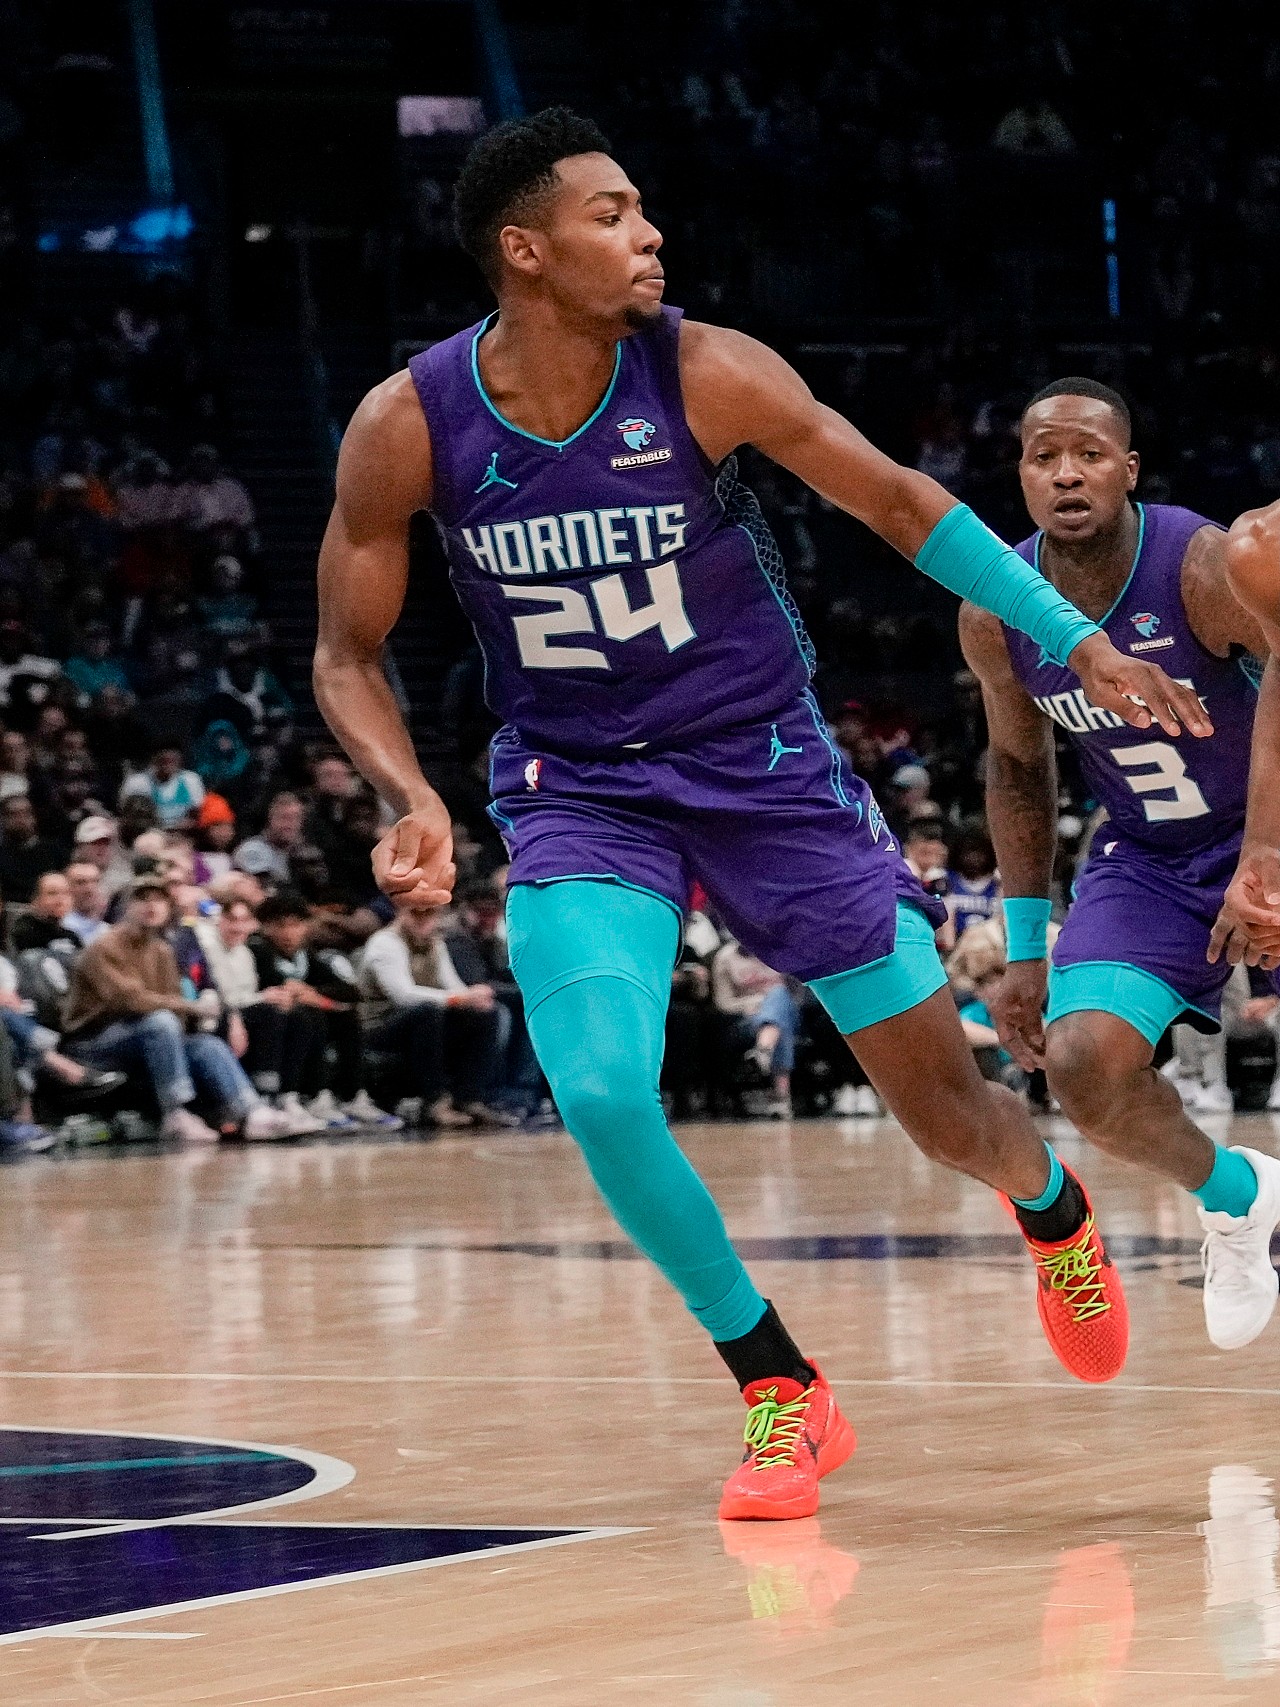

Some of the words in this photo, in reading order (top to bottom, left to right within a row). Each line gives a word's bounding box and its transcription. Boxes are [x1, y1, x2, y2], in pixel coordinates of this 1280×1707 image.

[611, 449, 671, 468] FEASTABLES
[461, 503, 691, 576] HORNETS
[500, 560, 698, 671] 24
[1109, 741, 1212, 822] 3
